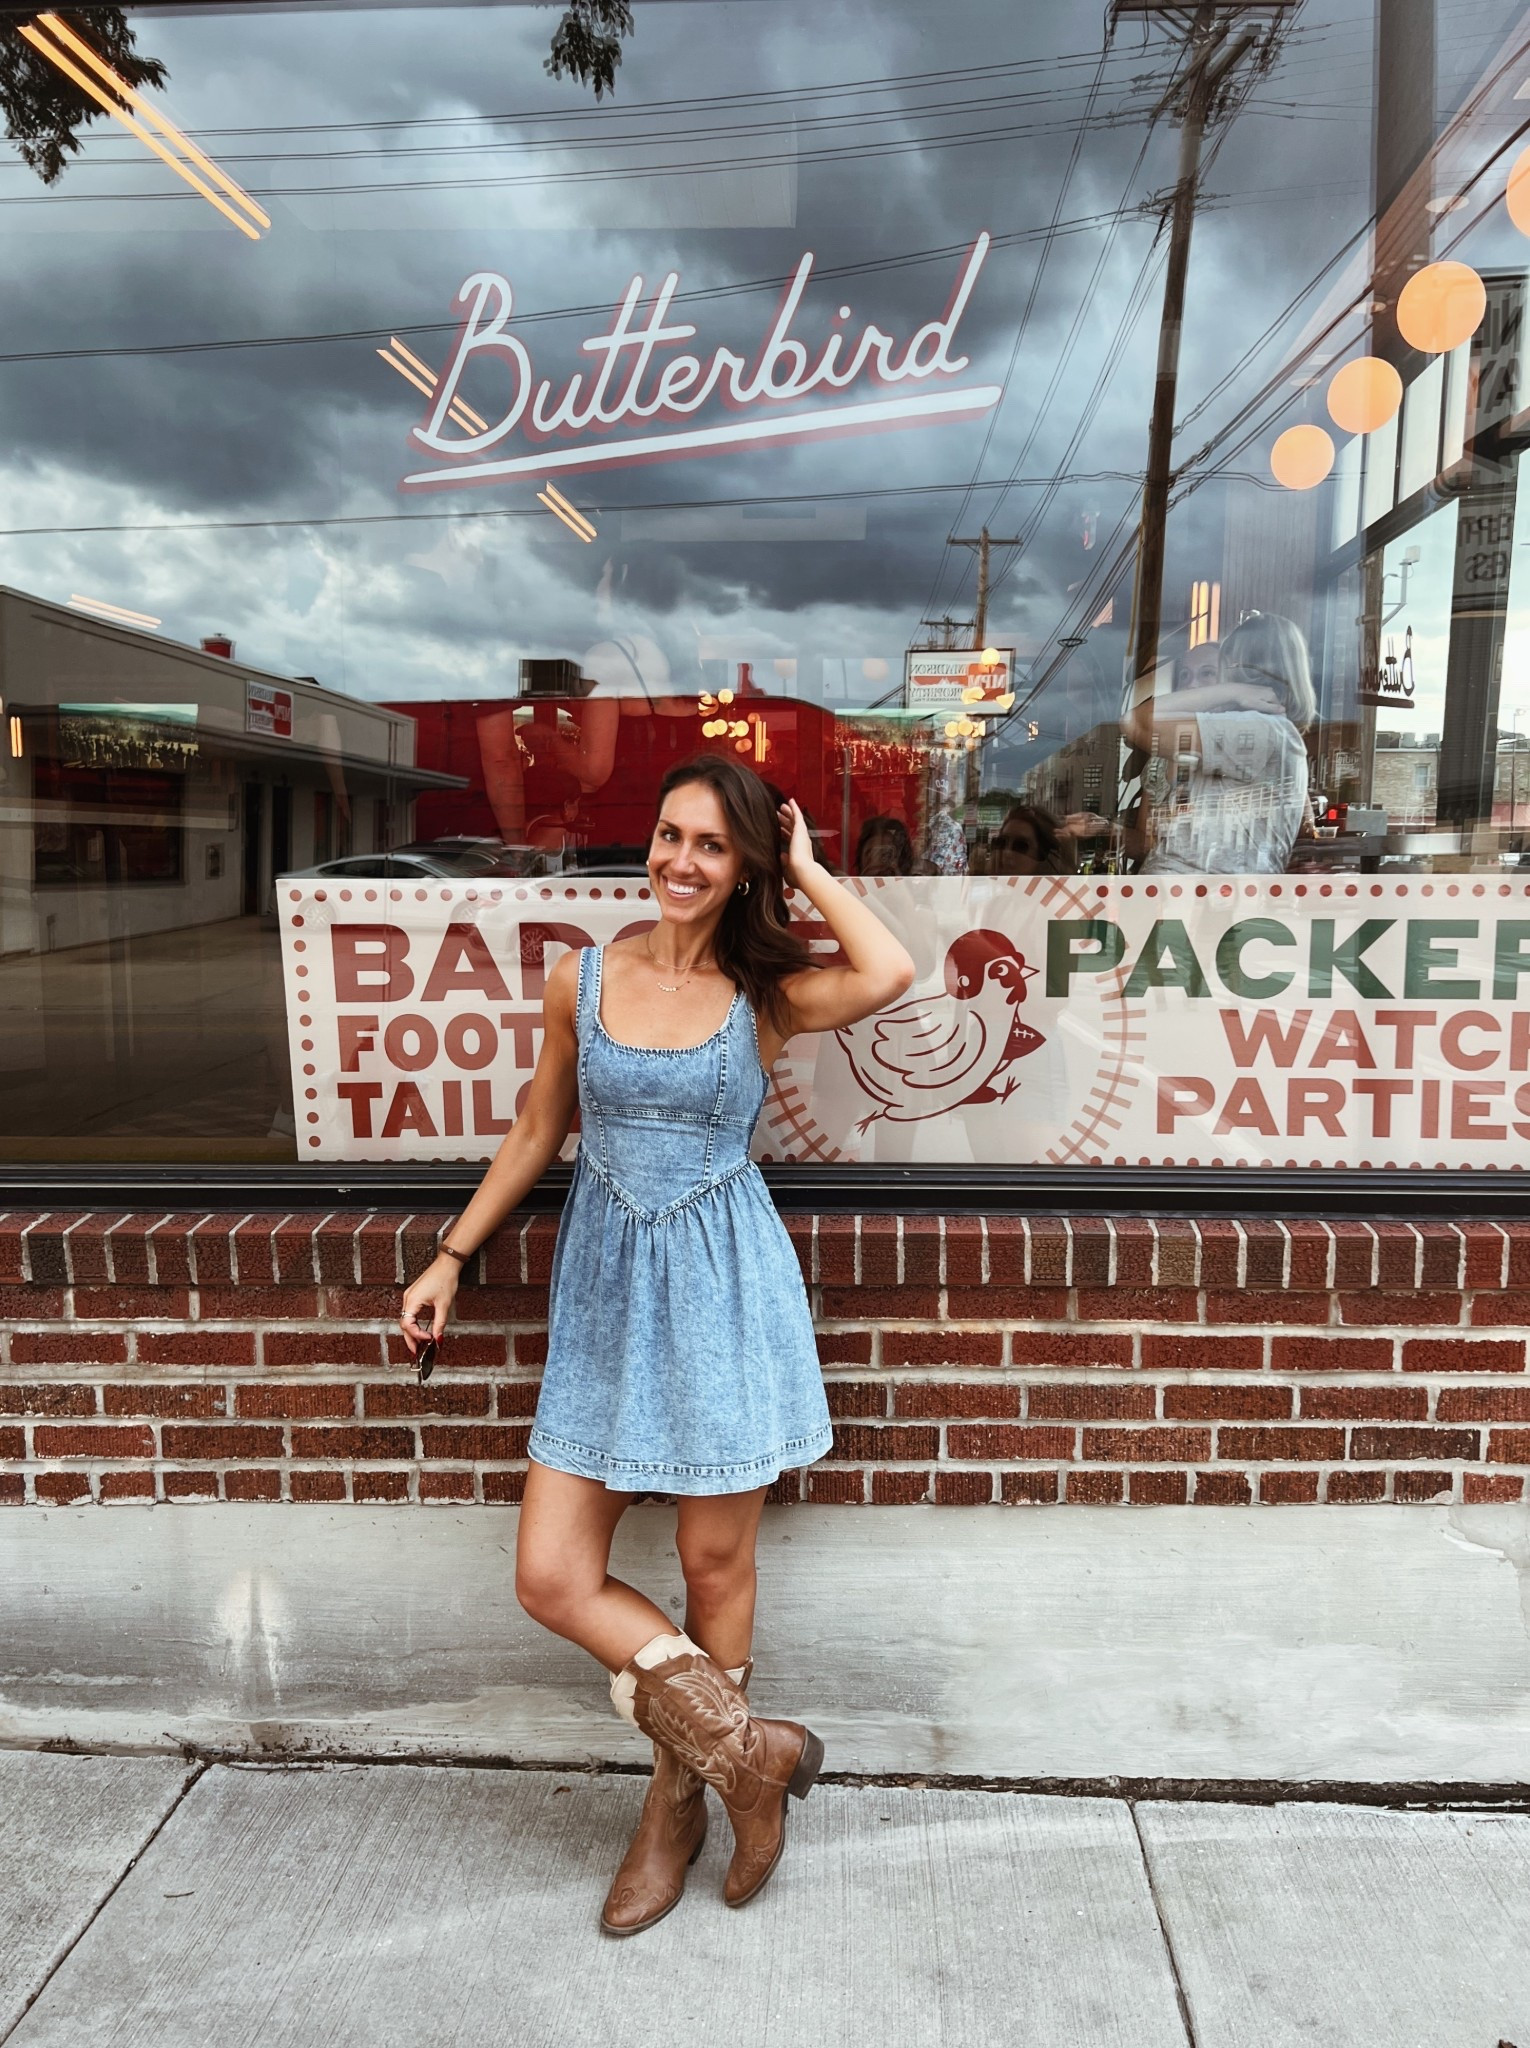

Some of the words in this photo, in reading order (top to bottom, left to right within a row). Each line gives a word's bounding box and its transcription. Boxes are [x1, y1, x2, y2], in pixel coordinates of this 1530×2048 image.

[407, 229, 991, 458] Butterbird
[337, 1012, 546, 1073] FOOT
[337, 1079, 536, 1139] TAIL
[1157, 1077, 1530, 1141] PARTIE
